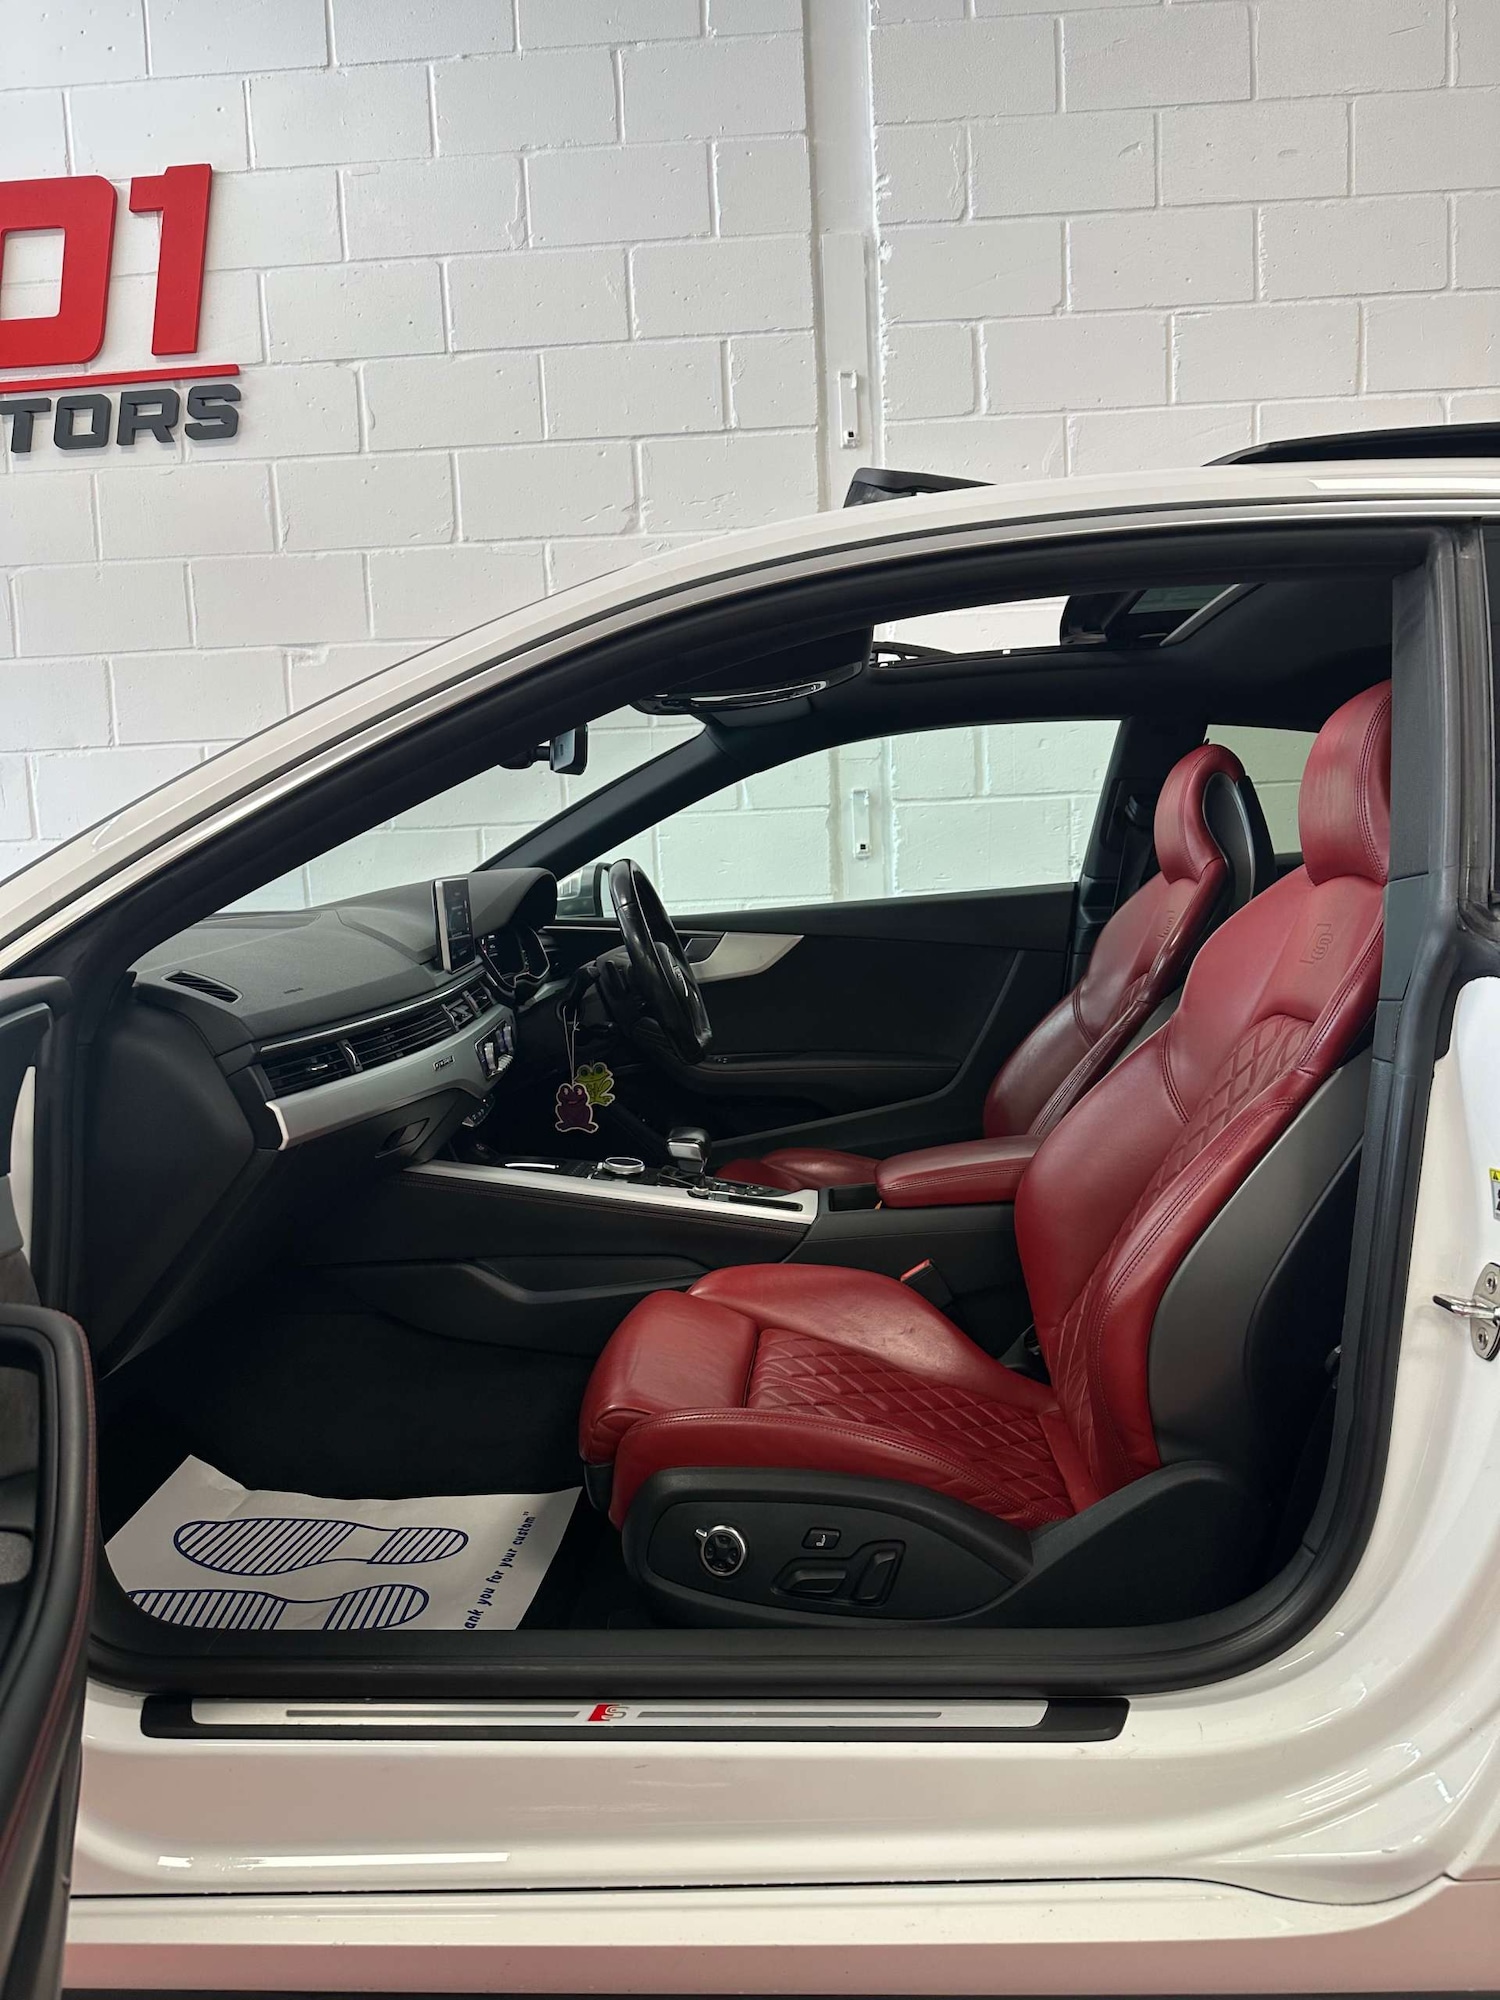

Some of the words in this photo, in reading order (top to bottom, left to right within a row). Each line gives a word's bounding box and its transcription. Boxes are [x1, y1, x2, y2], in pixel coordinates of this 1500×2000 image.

[0, 383, 241, 453] TORS
[477, 1587, 495, 1606] you
[486, 1570, 504, 1584] for
[498, 1548, 517, 1568] your
[600, 1703, 630, 1721] S
